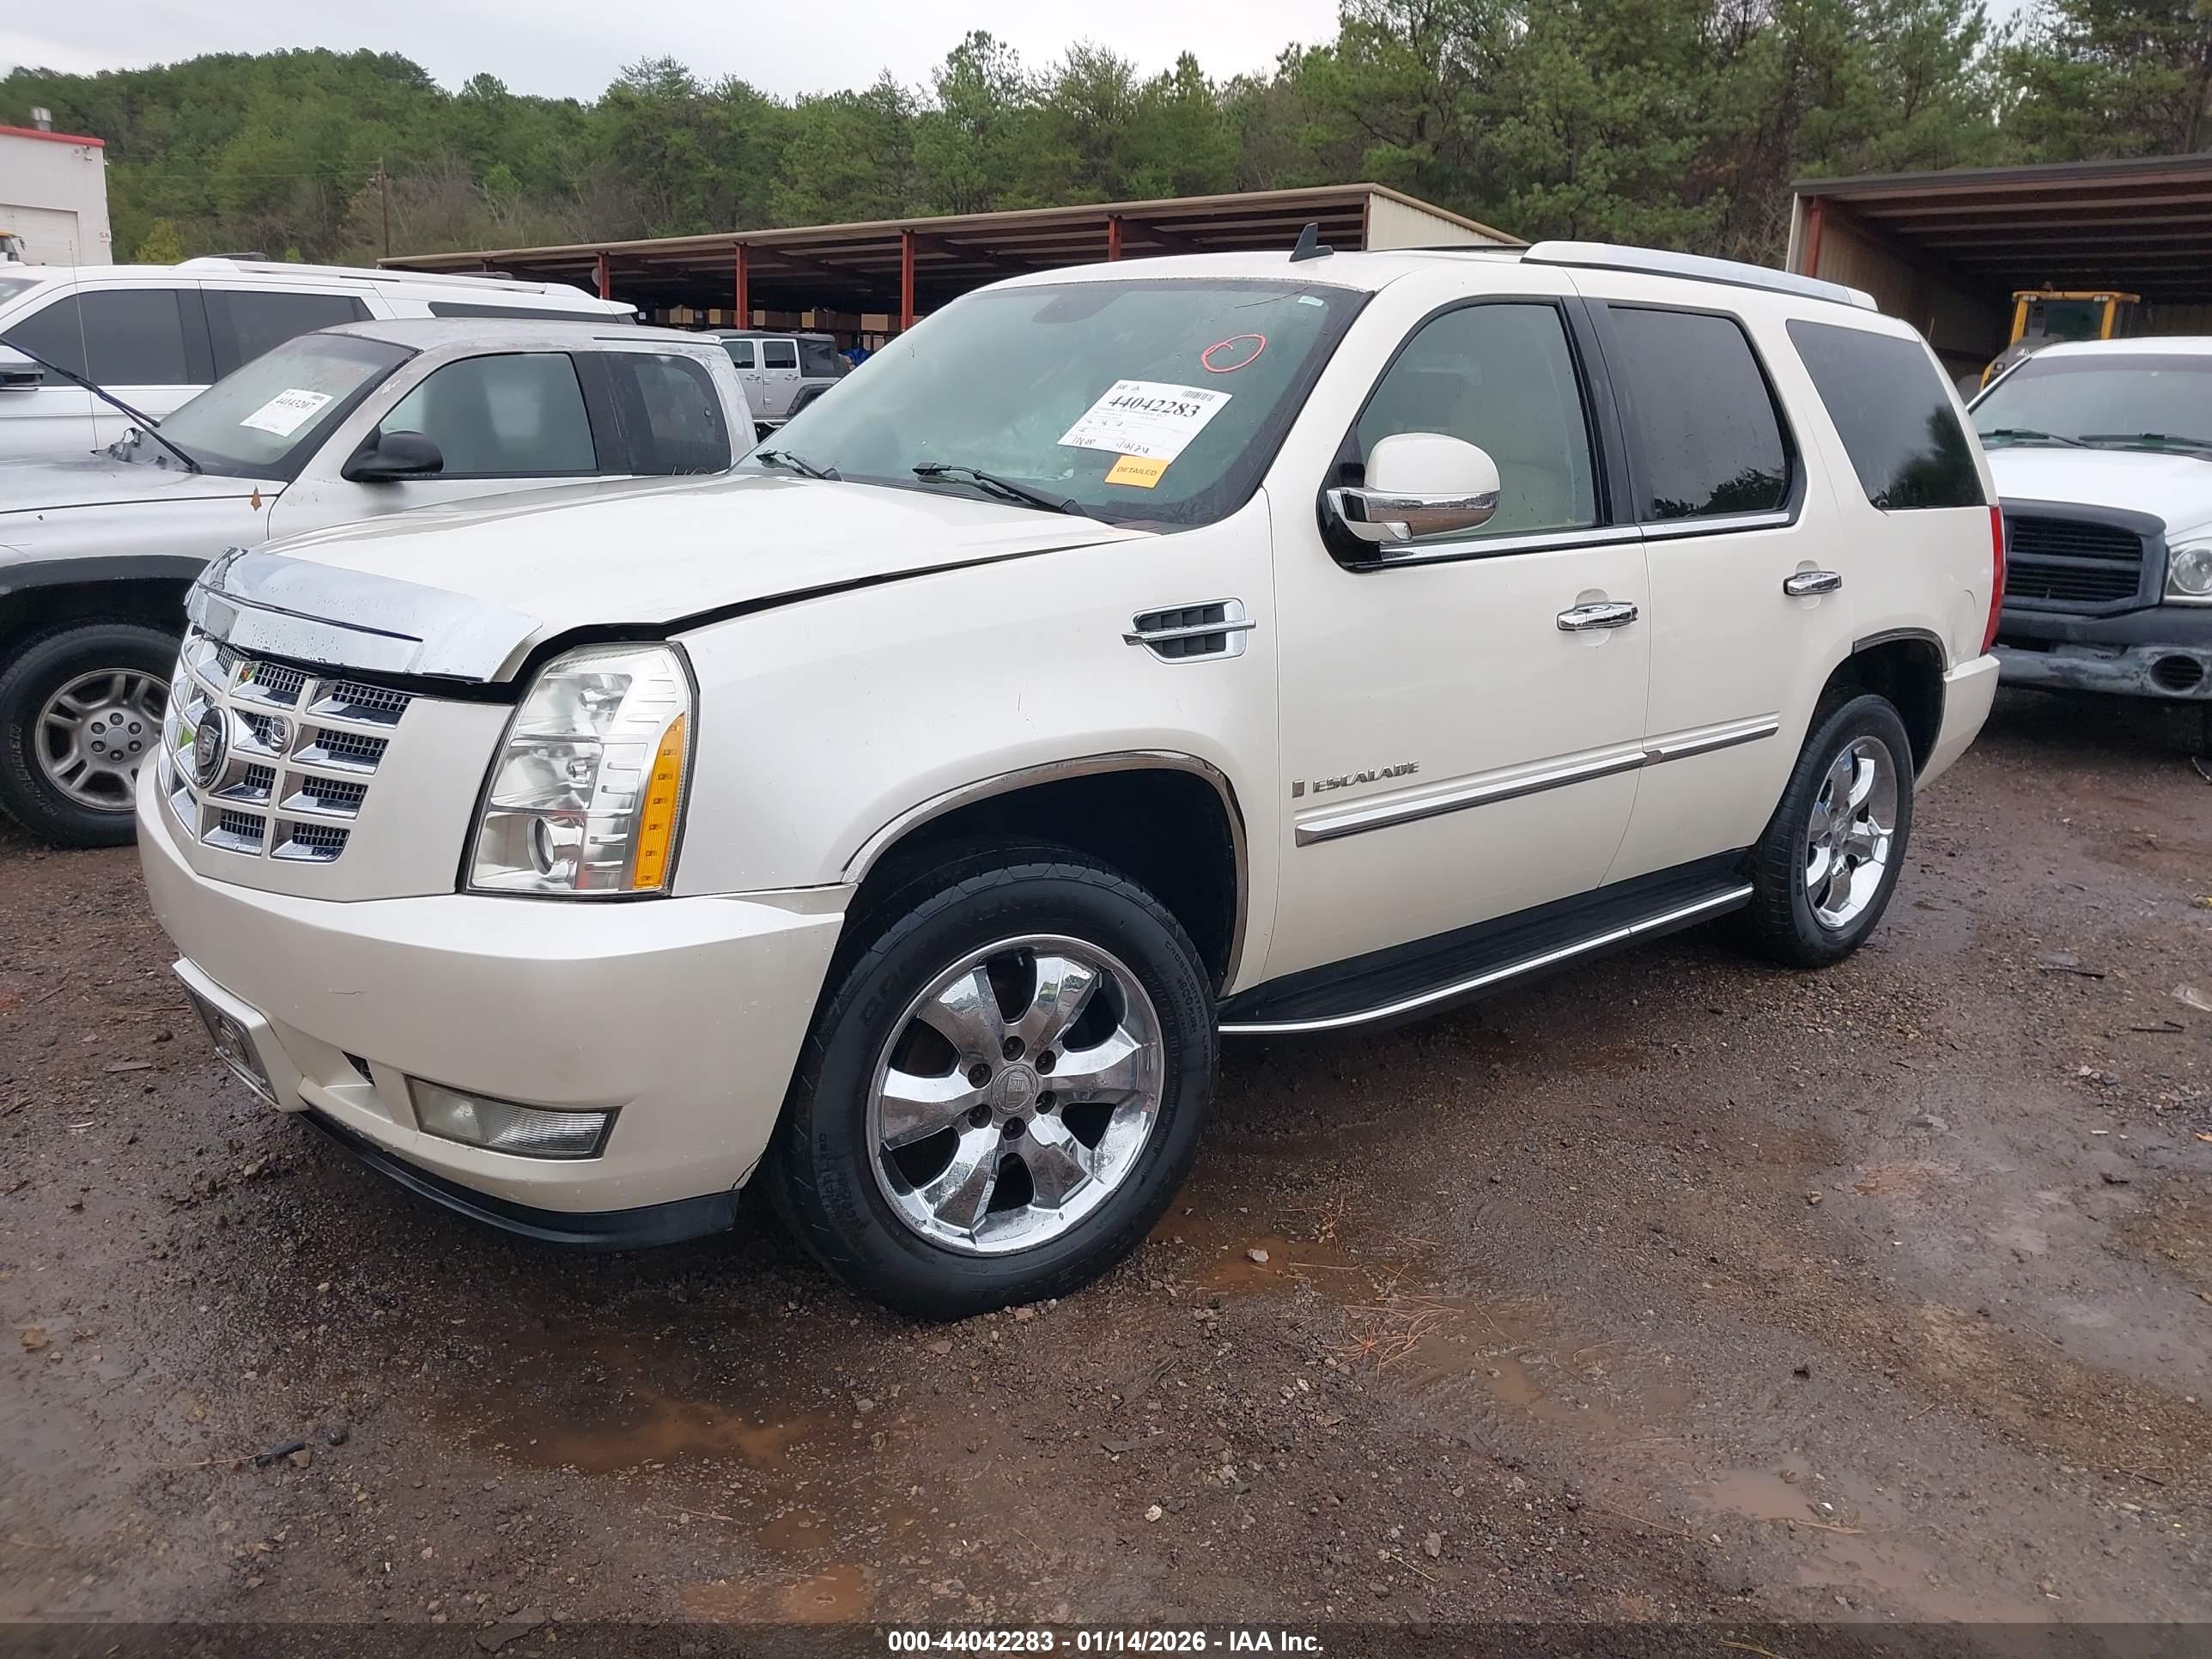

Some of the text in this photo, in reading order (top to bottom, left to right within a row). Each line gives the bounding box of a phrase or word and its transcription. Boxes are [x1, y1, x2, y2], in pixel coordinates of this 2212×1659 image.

[1109, 395, 1200, 417] 44042283
[1116, 466, 1158, 477] DETAILED
[1312, 760, 1419, 793] ESCALADE
